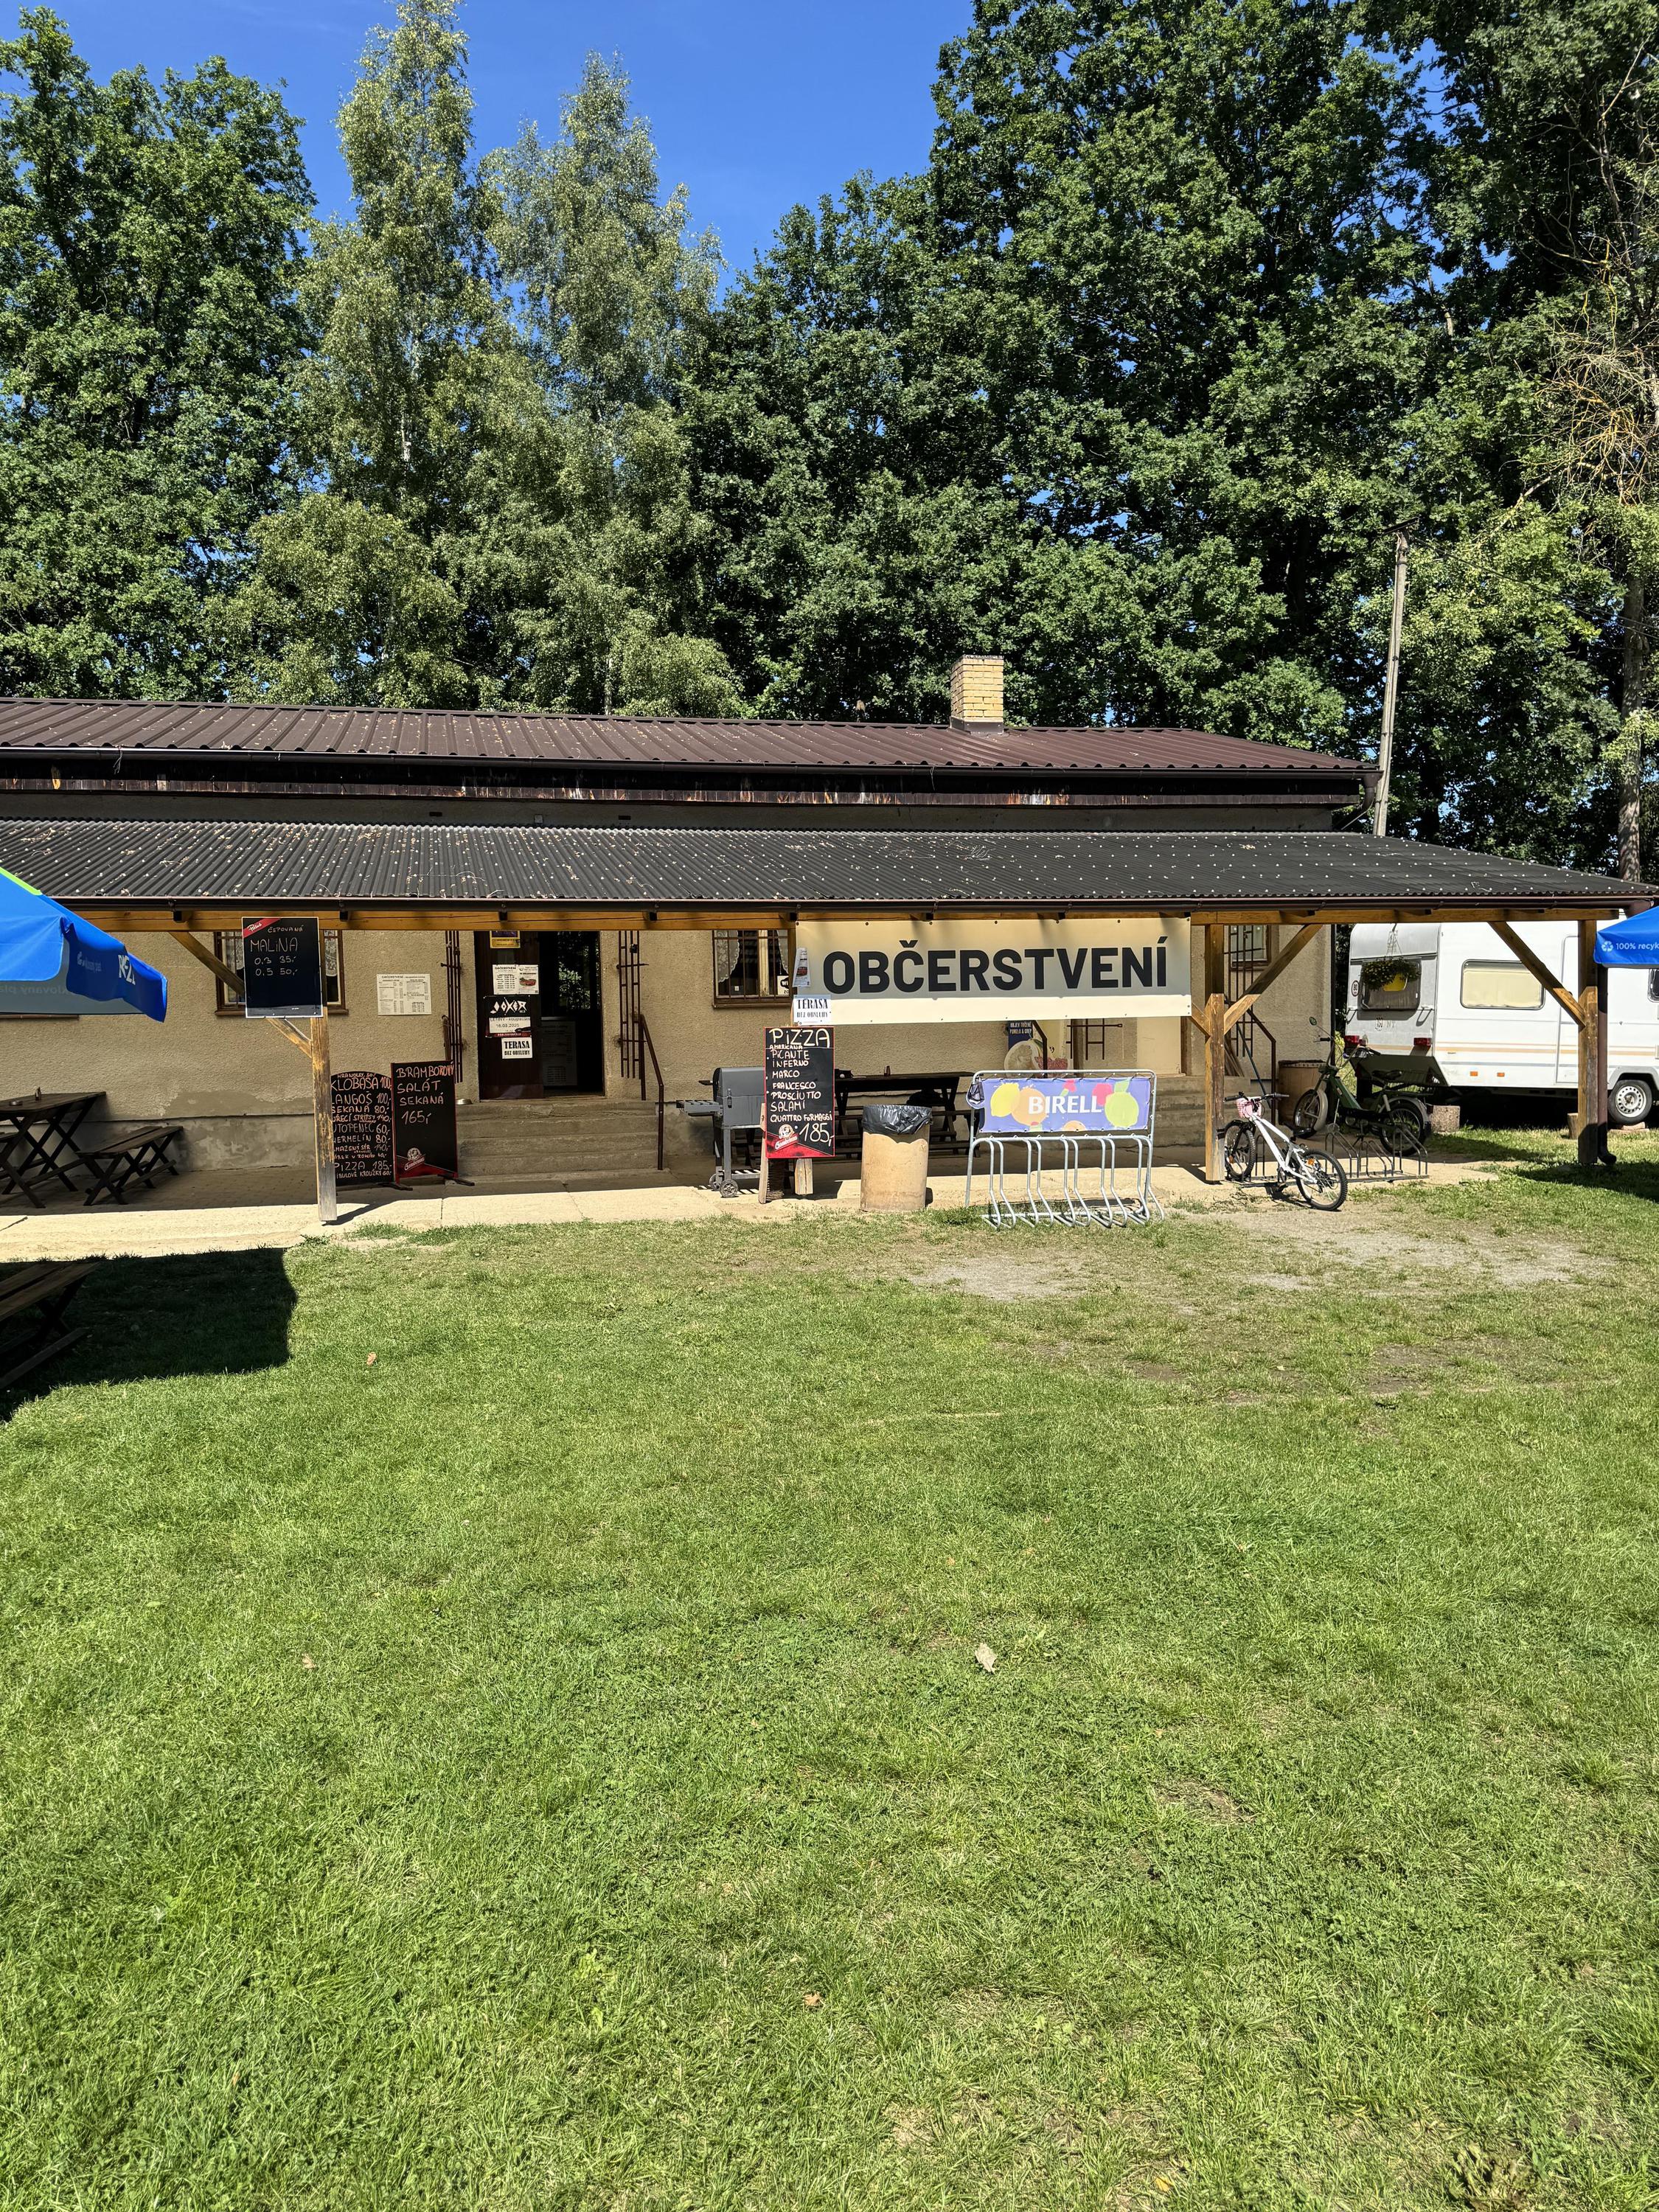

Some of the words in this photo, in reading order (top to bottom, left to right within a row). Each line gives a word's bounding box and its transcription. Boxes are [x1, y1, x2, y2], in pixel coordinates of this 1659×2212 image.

[823, 936, 1168, 995] OBČERSTVENÍ
[490, 997, 527, 1015] JOKER
[796, 998, 828, 1009] TERASA
[504, 1040, 530, 1049] TERASA
[396, 1061, 454, 1079] BRAMBOROVÝ
[772, 1070, 800, 1079] MARCO
[397, 1078, 441, 1094] SALÁT
[772, 1081, 816, 1091] FRANCESCO
[332, 1091, 373, 1105] ANGOŠ
[400, 1092, 444, 1106] SEKANÁ
[1029, 1095, 1103, 1115] BIRELL
[770, 1114, 802, 1123] QUATTRO
